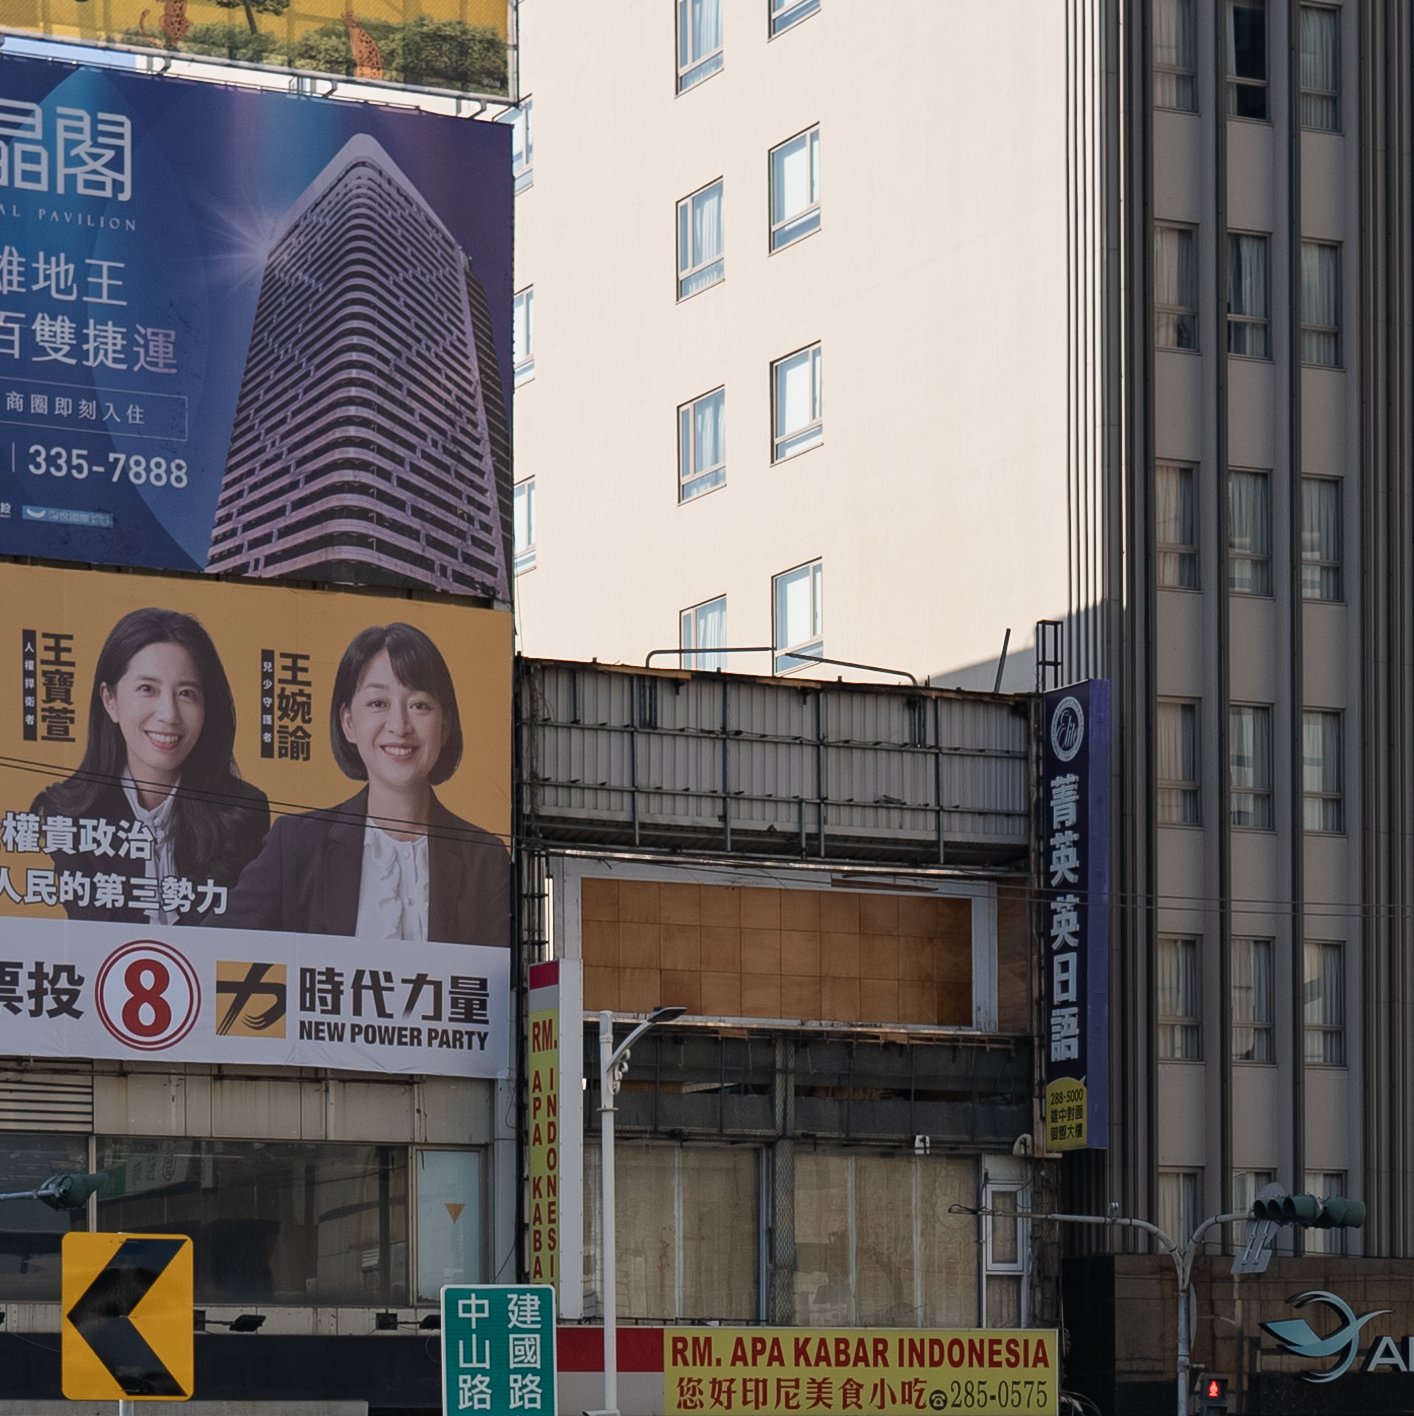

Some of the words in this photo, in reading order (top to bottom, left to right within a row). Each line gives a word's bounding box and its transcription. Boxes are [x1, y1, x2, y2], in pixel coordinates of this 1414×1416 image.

[37, 208, 137, 231] PAVILION
[28, 444, 189, 489] 335-7888
[24, 641, 36, 726] 人權捍衛者
[40, 632, 77, 743] 王寶萱
[262, 661, 274, 744] 兒少守護者
[277, 652, 313, 762] 王婉諭
[120, 957, 171, 1037] 8
[299, 964, 491, 1024] 時代力量
[299, 1020, 347, 1043] NEW
[348, 1022, 423, 1048] POWER
[426, 1027, 490, 1052] PARTY
[531, 1018, 558, 1053] RM.
[531, 1069, 543, 1147] APA
[546, 1066, 558, 1287] INDONESI
[531, 1175, 544, 1286] KABA
[457, 1292, 492, 1410] 中山路
[506, 1292, 542, 1410] 建國路
[671, 1336, 722, 1367] RM.
[730, 1336, 786, 1368] APA
[794, 1337, 890, 1368] KABAR
[898, 1338, 1050, 1369] INDONESIA
[676, 1376, 928, 1411] 您好印尼美食小吃
[950, 1380, 1049, 1410] 285-0575
